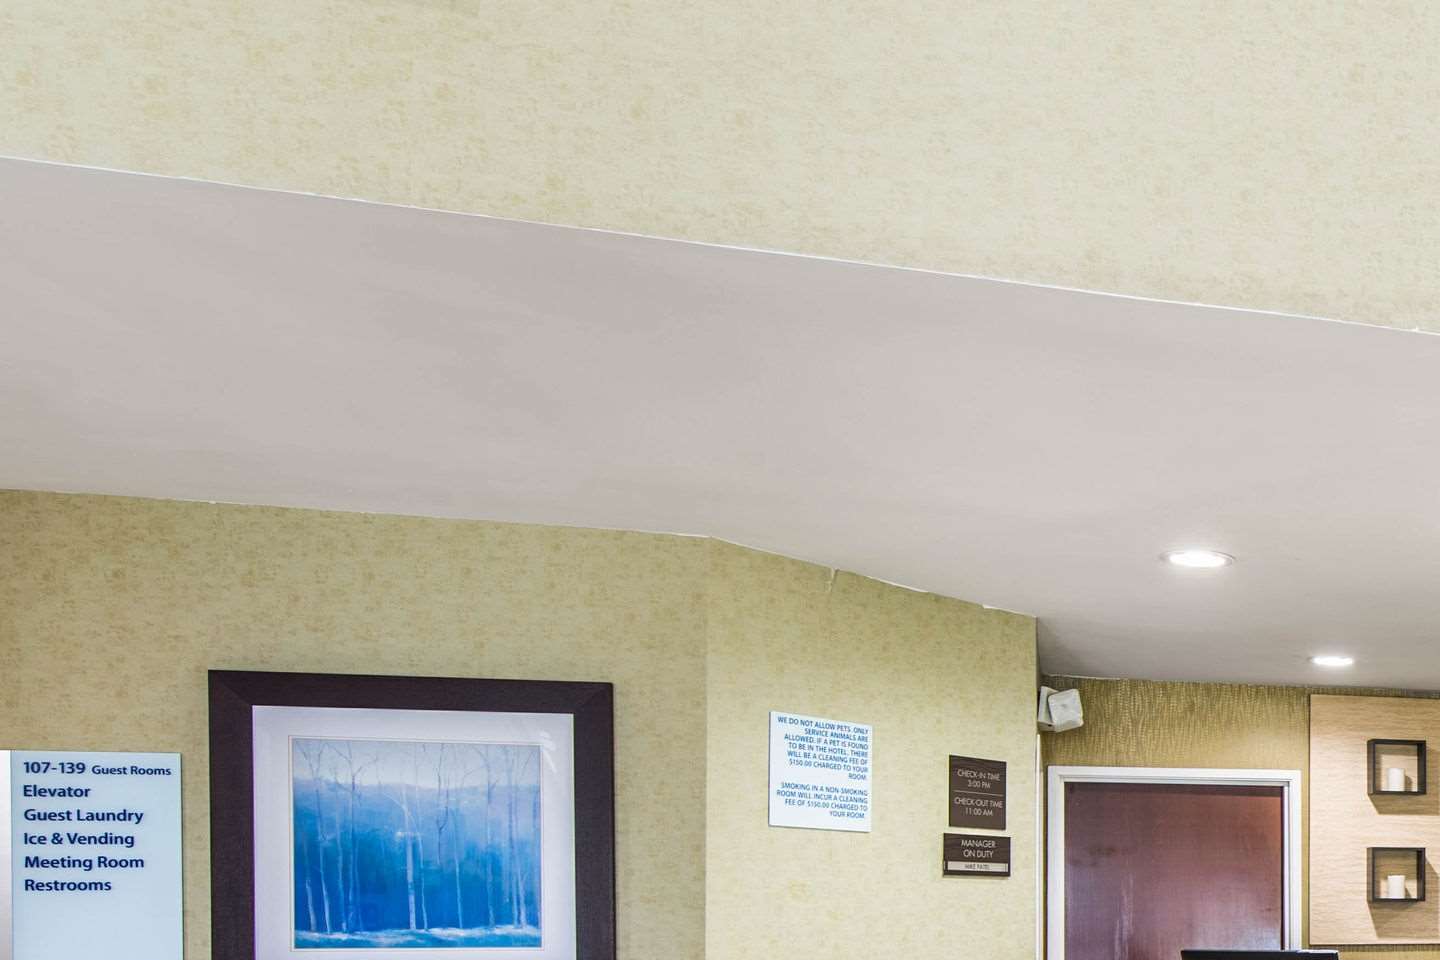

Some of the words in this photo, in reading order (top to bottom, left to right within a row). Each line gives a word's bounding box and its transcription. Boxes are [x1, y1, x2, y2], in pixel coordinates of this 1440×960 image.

[815, 722, 835, 730] ALLOW
[805, 728, 828, 737] SERVICE
[830, 732, 856, 741] ANIMALS
[848, 742, 868, 750] FOUND
[787, 750, 801, 758] WILL
[818, 754, 847, 763] CLEANING
[850, 750, 868, 758] THERE
[24, 762, 86, 774] 107-139
[92, 765, 128, 775] Guest
[130, 766, 172, 776] Rooms
[813, 761, 841, 770] CHARGED
[24, 784, 90, 798] Elevator
[782, 782, 810, 791] SMOKING
[839, 796, 868, 804] CLEANING
[831, 803, 858, 811] CHARGED
[24, 808, 72, 822] Guest
[76, 809, 144, 824] Laundry
[24, 832, 47, 845] Ice
[51, 833, 63, 845] &
[67, 832, 135, 848] Vending
[961, 840, 996, 848] MANAGER
[963, 850, 975, 858] ON
[977, 850, 994, 858] DUTY
[24, 856, 93, 871] Meeting
[98, 856, 144, 868] Room
[24, 879, 112, 892] Restrooms
